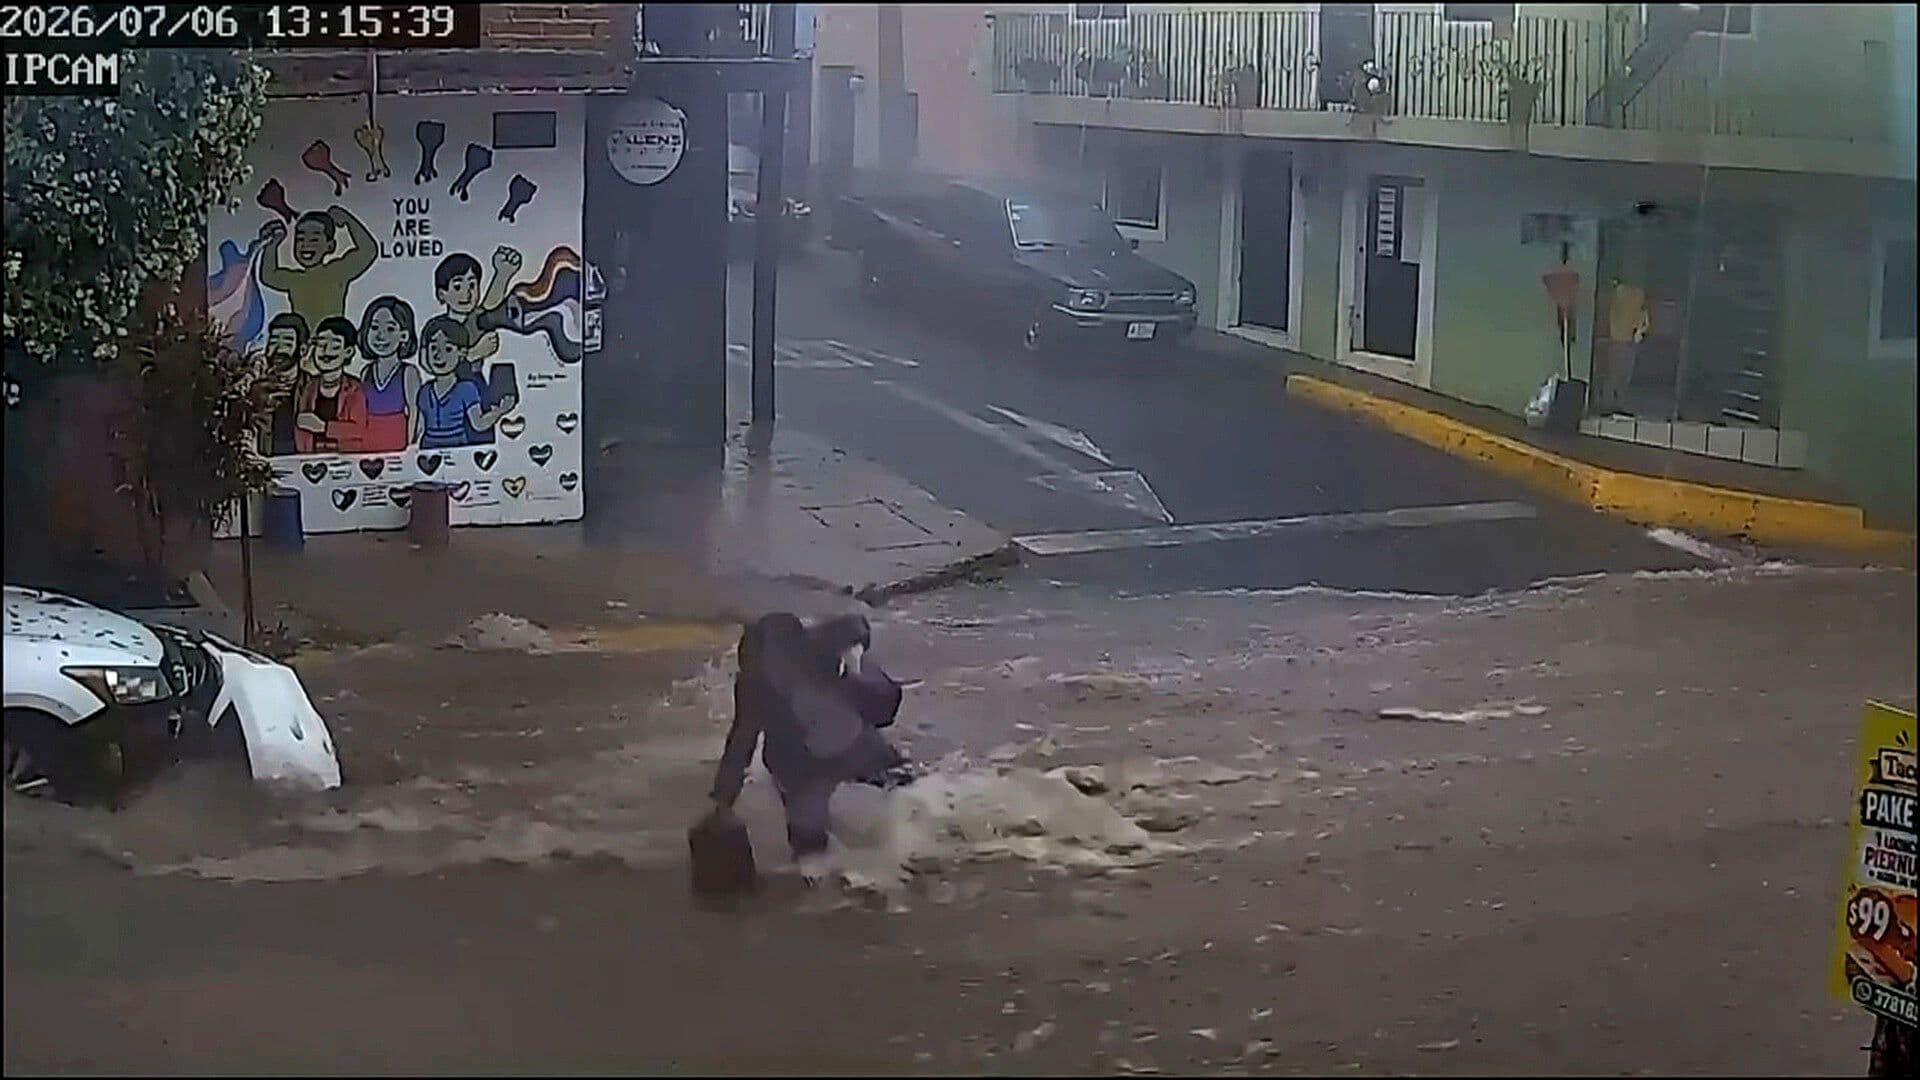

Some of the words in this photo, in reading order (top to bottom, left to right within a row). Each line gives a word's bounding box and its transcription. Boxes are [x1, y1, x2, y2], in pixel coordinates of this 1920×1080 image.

[393, 197, 430, 216] YOU
[393, 219, 431, 237] ARE
[380, 239, 443, 258] LOVED
[1849, 897, 1889, 941] $99
[1873, 988, 1918, 1021] 37818
